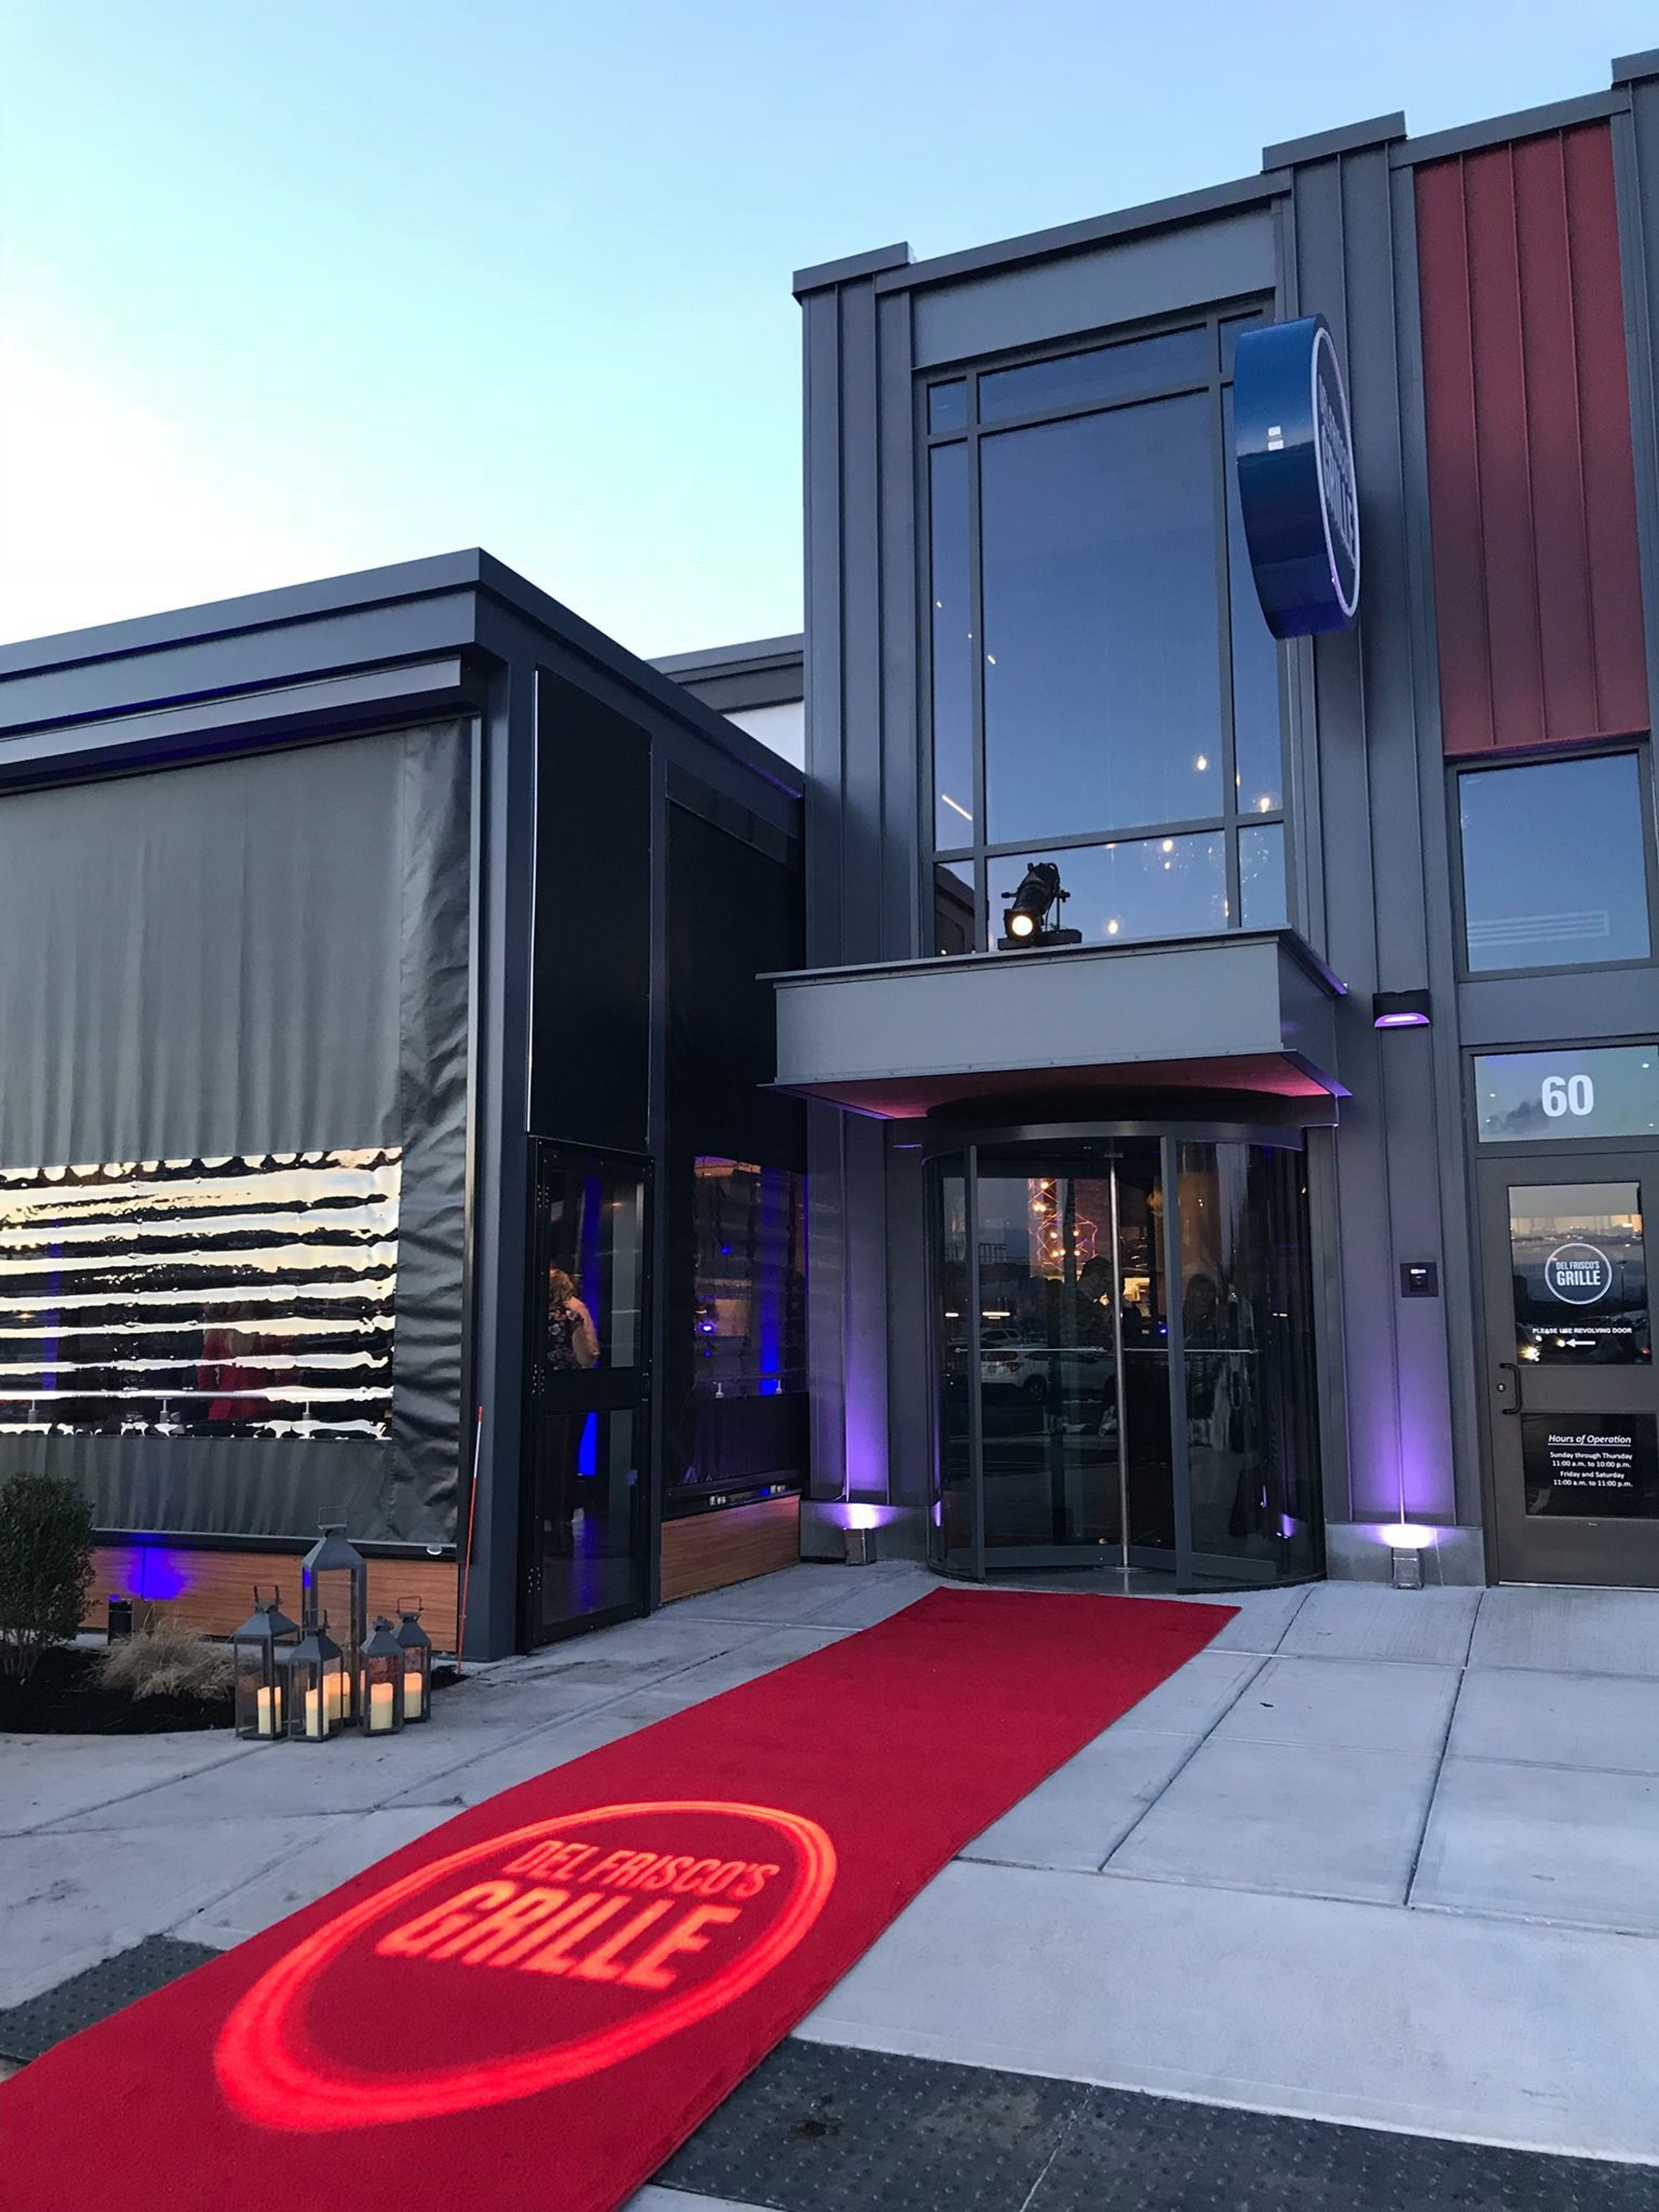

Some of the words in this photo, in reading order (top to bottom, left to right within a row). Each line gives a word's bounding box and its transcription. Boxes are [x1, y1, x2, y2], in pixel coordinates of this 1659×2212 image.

[1541, 1074, 1594, 1118] 60
[1556, 1262, 1569, 1270] DEL
[1570, 1261, 1600, 1269] FRISCO'S
[1557, 1270, 1601, 1286] GRILLE
[1548, 1434, 1574, 1443] Hours
[1576, 1434, 1586, 1445] of
[1587, 1435, 1631, 1445] Operation
[1595, 1471, 1624, 1479] Saturday
[502, 1840, 600, 1883] DEL
[578, 1849, 781, 1898] FRISCO'S
[373, 1879, 744, 1990] GRILLE
